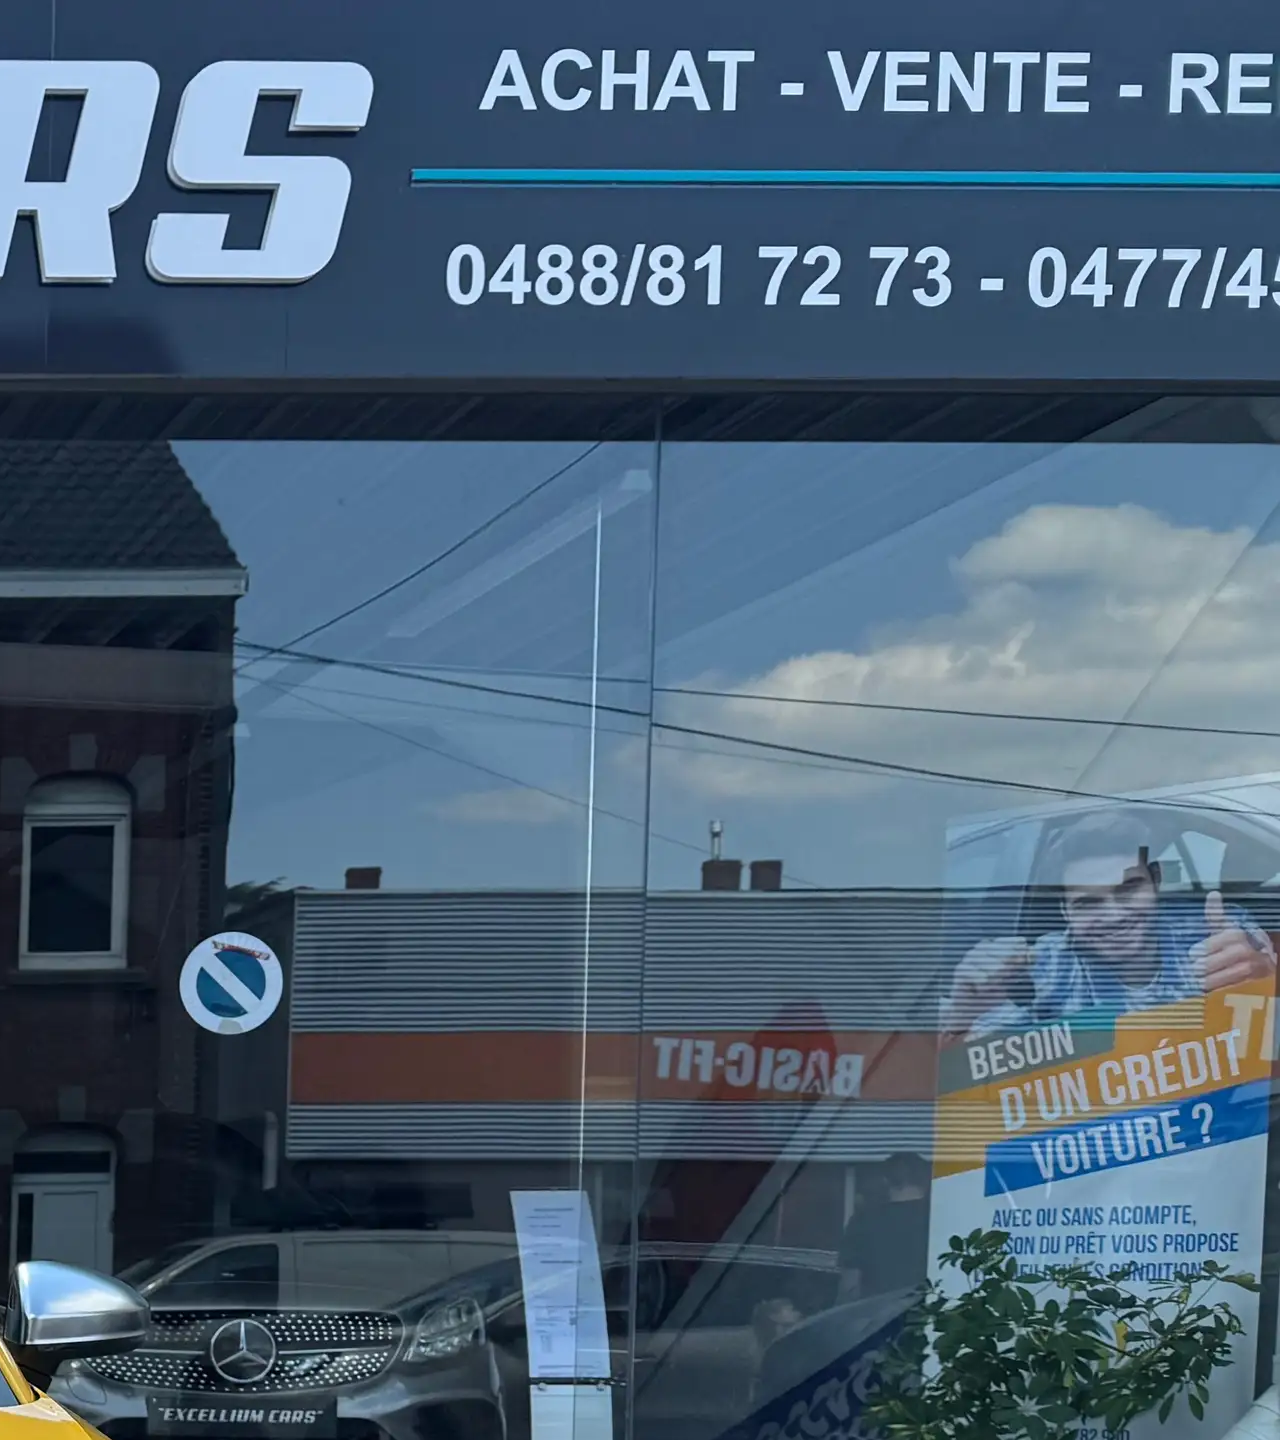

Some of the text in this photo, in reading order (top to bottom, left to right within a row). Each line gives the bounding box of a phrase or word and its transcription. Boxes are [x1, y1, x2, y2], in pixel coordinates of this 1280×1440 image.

[478, 48, 755, 111] ACHAT
[827, 51, 1091, 113] VENTE
[446, 243, 722, 306] 0488/81
[758, 245, 842, 306] 72
[869, 246, 952, 307] 73
[1028, 246, 1280, 309] 0477/4
[968, 1021, 1075, 1081] BESOIN
[1098, 1029, 1243, 1106] CRÉDIT
[1031, 1102, 1214, 1180] VOITURE ?
[992, 1205, 1197, 1228] AVEC OU SANS ACOMPTE,
[1040, 1234, 1061, 1255] DU
[1064, 1231, 1107, 1254] PRÊT
[1111, 1233, 1158, 1253] VOUS
[1163, 1232, 1239, 1253] PROPOSE
[163, 1407, 317, 1424] EXCELLIUM CARS
